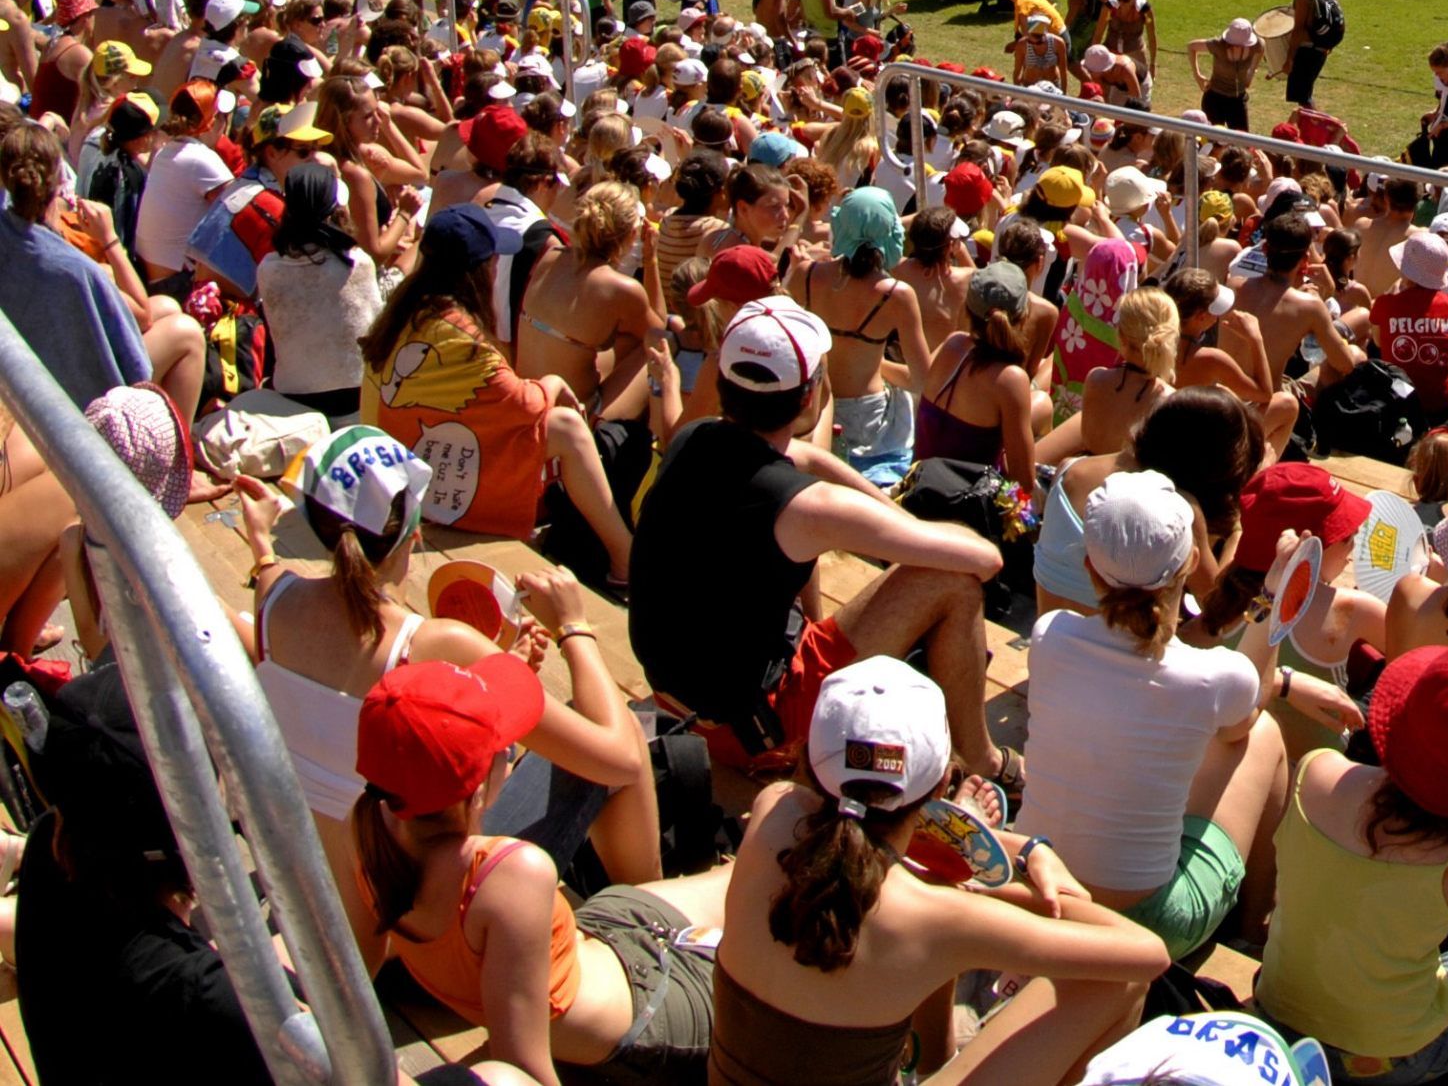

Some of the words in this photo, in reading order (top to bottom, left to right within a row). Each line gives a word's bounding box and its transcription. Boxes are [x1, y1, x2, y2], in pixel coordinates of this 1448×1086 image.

[330, 443, 416, 490] BRASI
[456, 446, 475, 481] Don't
[451, 488, 467, 511] hate
[876, 758, 904, 772] 2007
